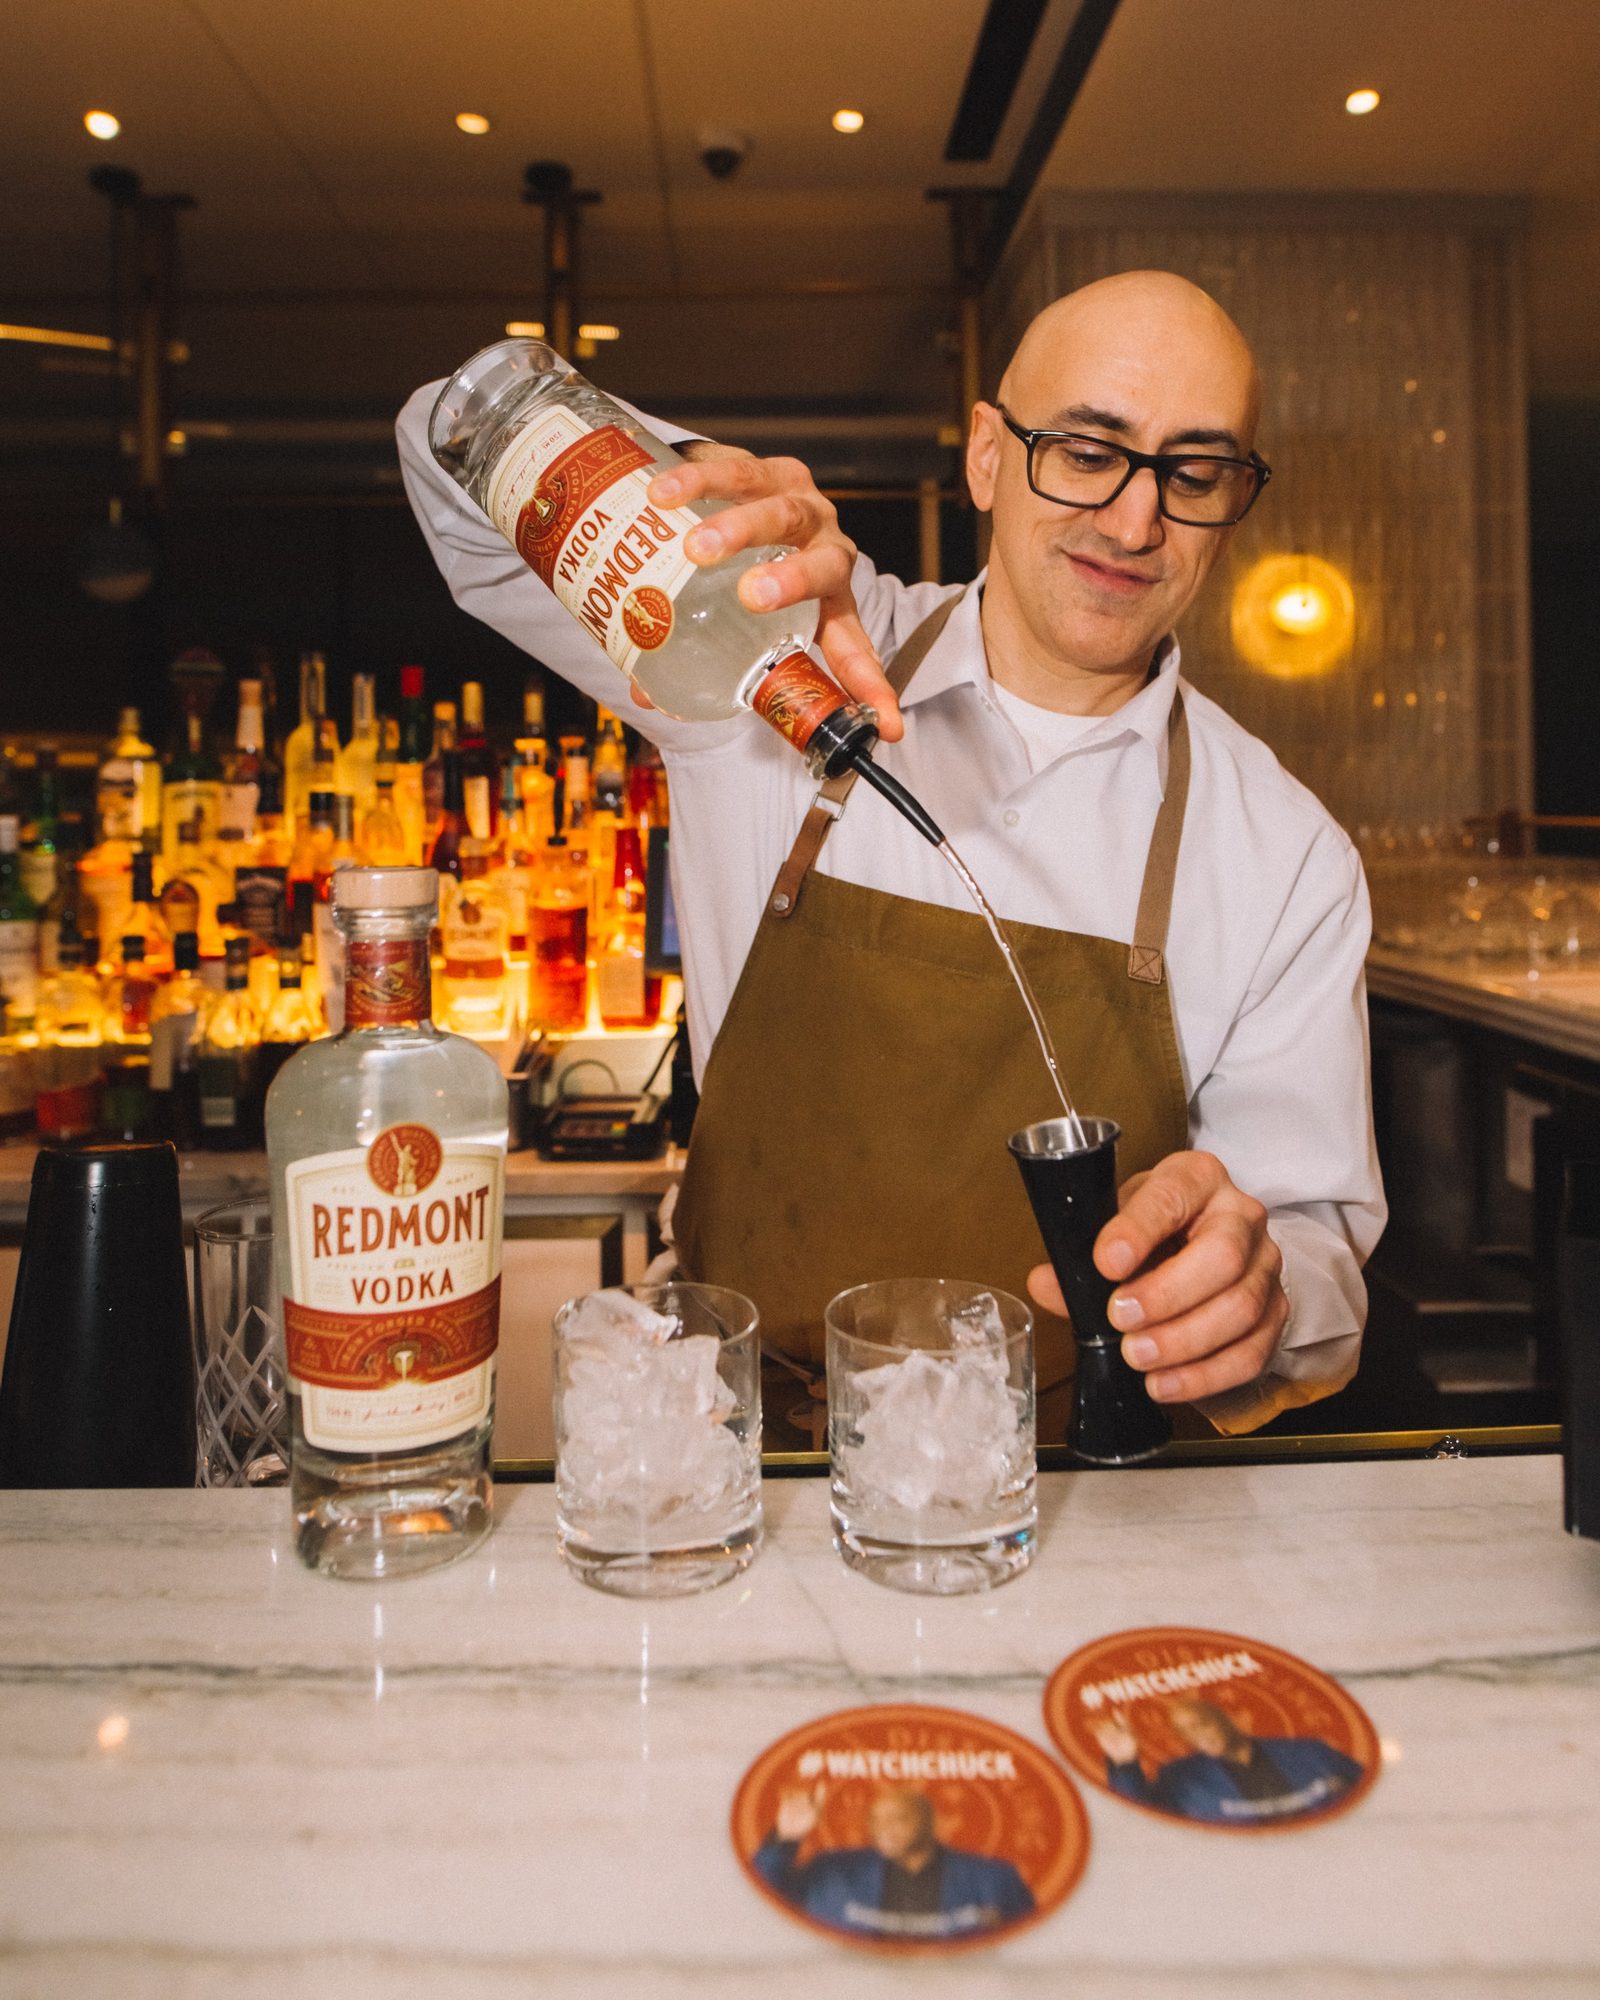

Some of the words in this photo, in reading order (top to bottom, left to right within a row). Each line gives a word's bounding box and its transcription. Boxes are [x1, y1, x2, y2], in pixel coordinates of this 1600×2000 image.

[568, 466, 579, 494] IRON
[552, 500, 577, 543] FORGED
[558, 508, 613, 584] VODKA
[579, 505, 677, 651] REDMONT
[640, 590, 670, 618] REDMONT
[313, 1184, 489, 1259] REDMONT
[351, 1268, 454, 1305] VODKA
[366, 1316, 425, 1337] FORGED
[1080, 1651, 1262, 1709] #WATCHCHUCK
[798, 1750, 1016, 1781] #WATCHCHUCK
